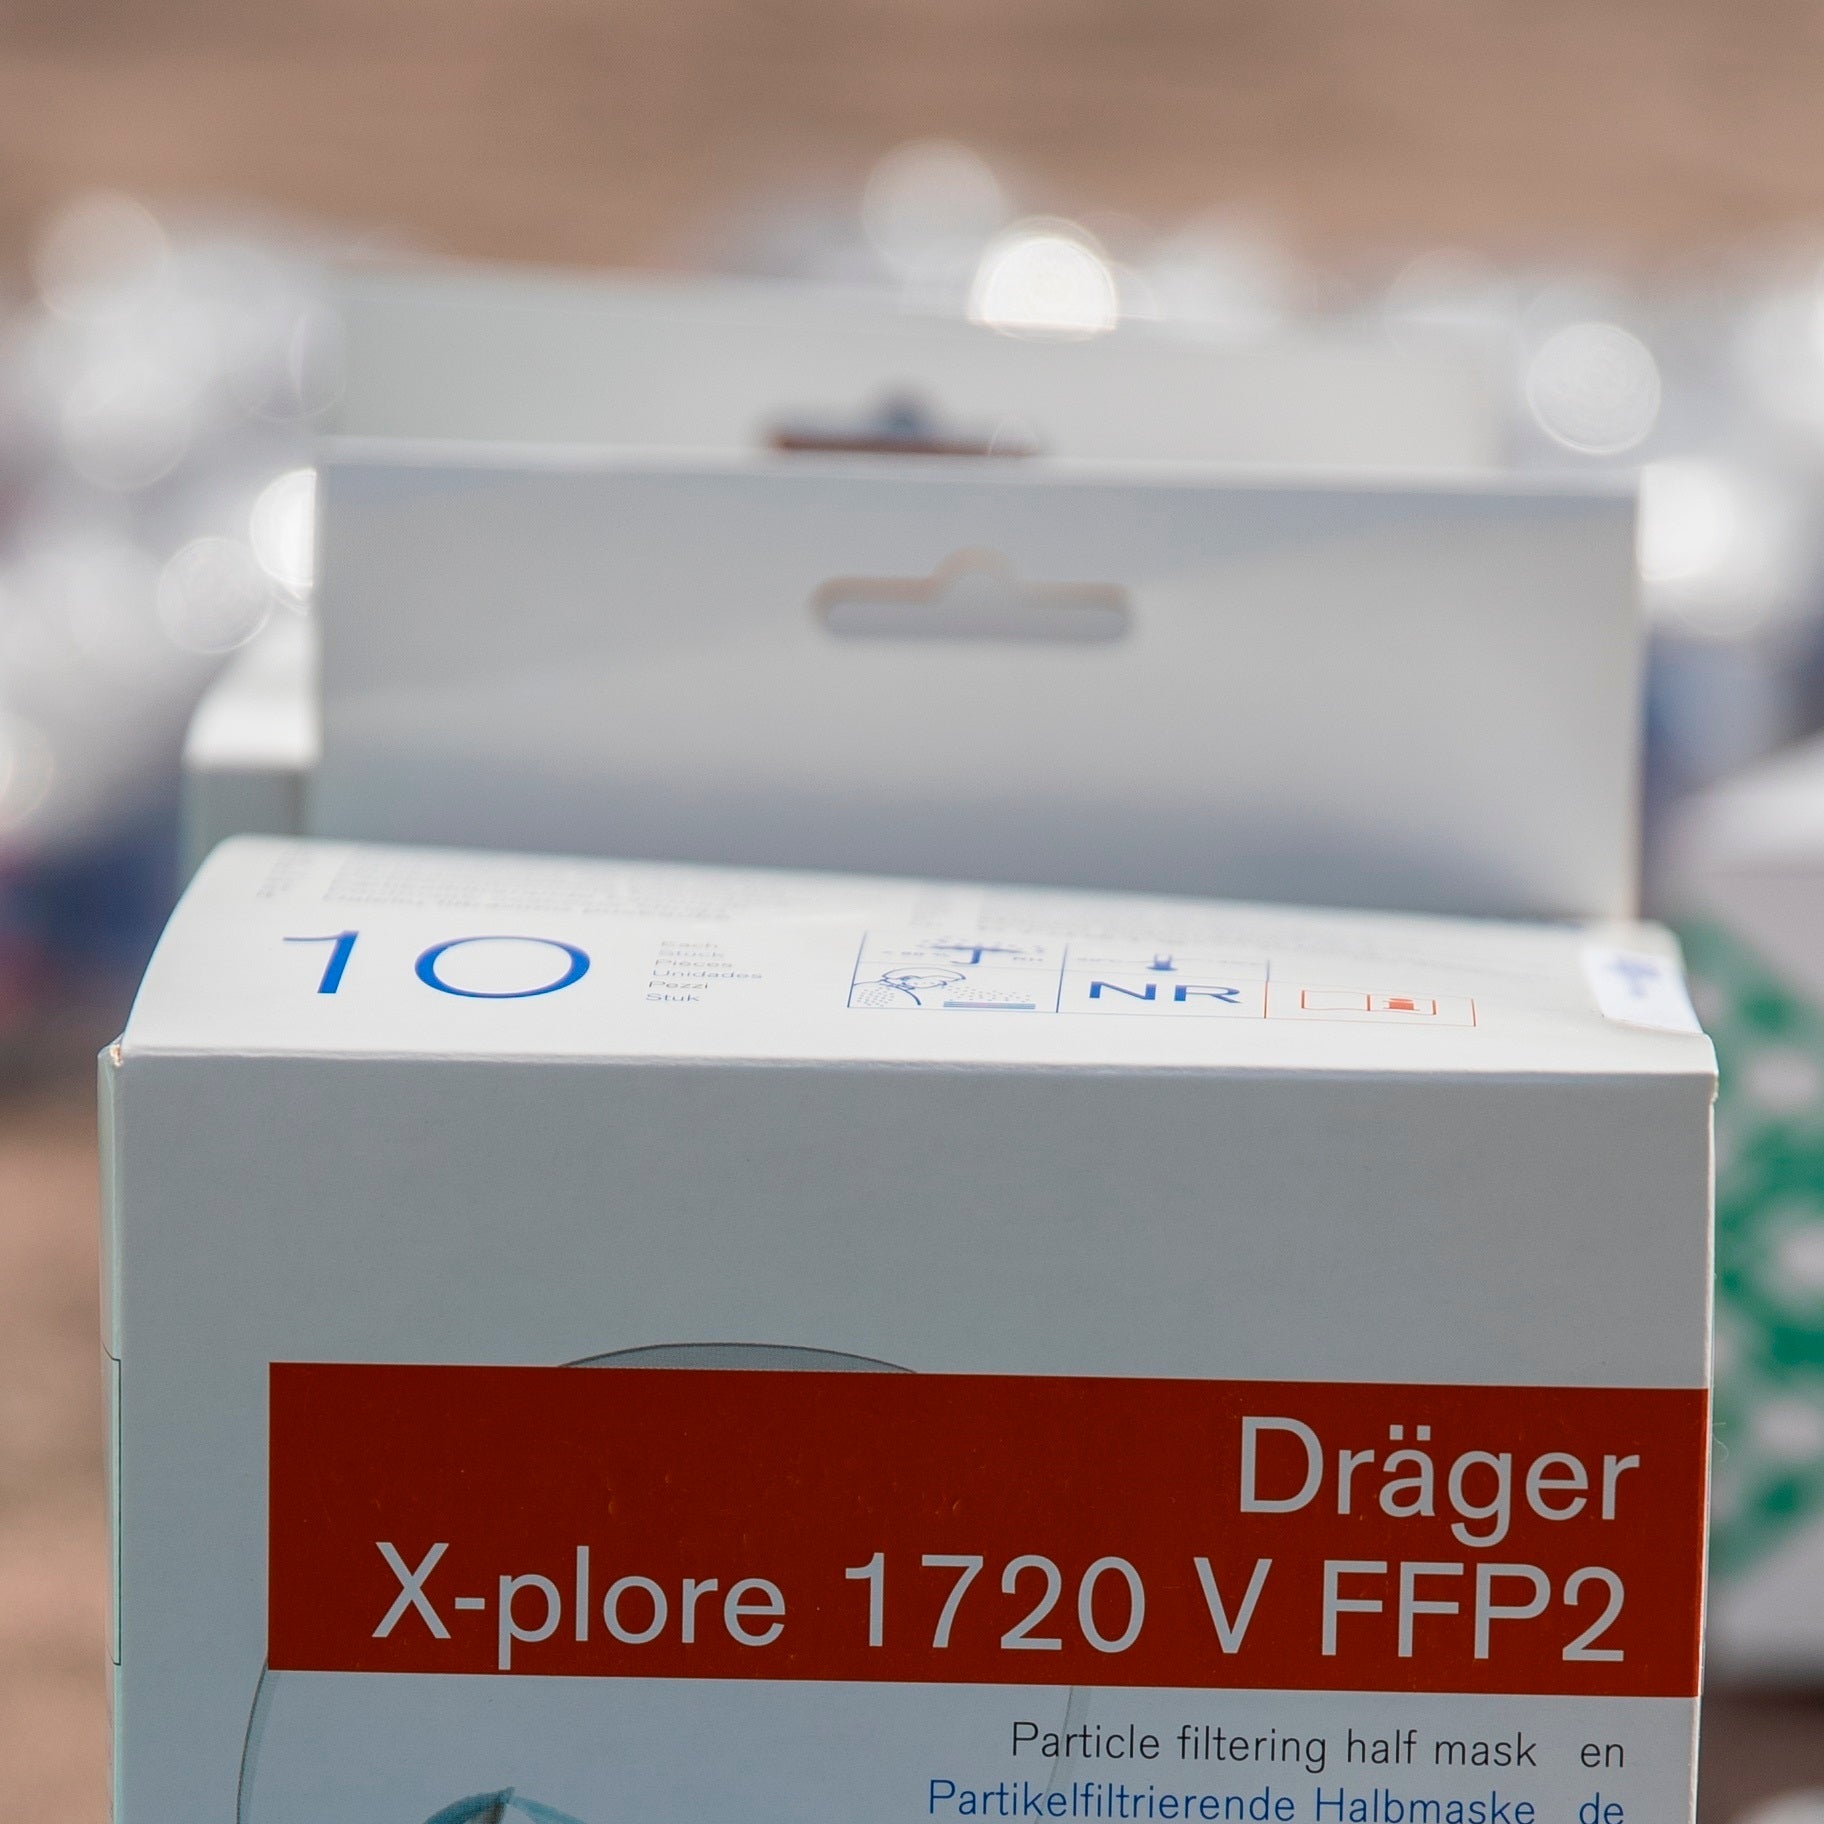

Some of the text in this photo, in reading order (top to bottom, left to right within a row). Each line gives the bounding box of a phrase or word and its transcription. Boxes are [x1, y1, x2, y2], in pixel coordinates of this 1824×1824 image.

[282, 929, 592, 1000] 10
[648, 980, 708, 990] Pezzi
[652, 969, 763, 980] Unidades
[646, 992, 700, 1002] Stuk
[1088, 980, 1242, 1005] NR
[1239, 1415, 1640, 1548] Dräger
[371, 1540, 1626, 1668] X-plore 1720 V FFP2
[1012, 1721, 1625, 1774] Particle filtering half mask en
[929, 1778, 1295, 1823] Partikelfiltrierende
